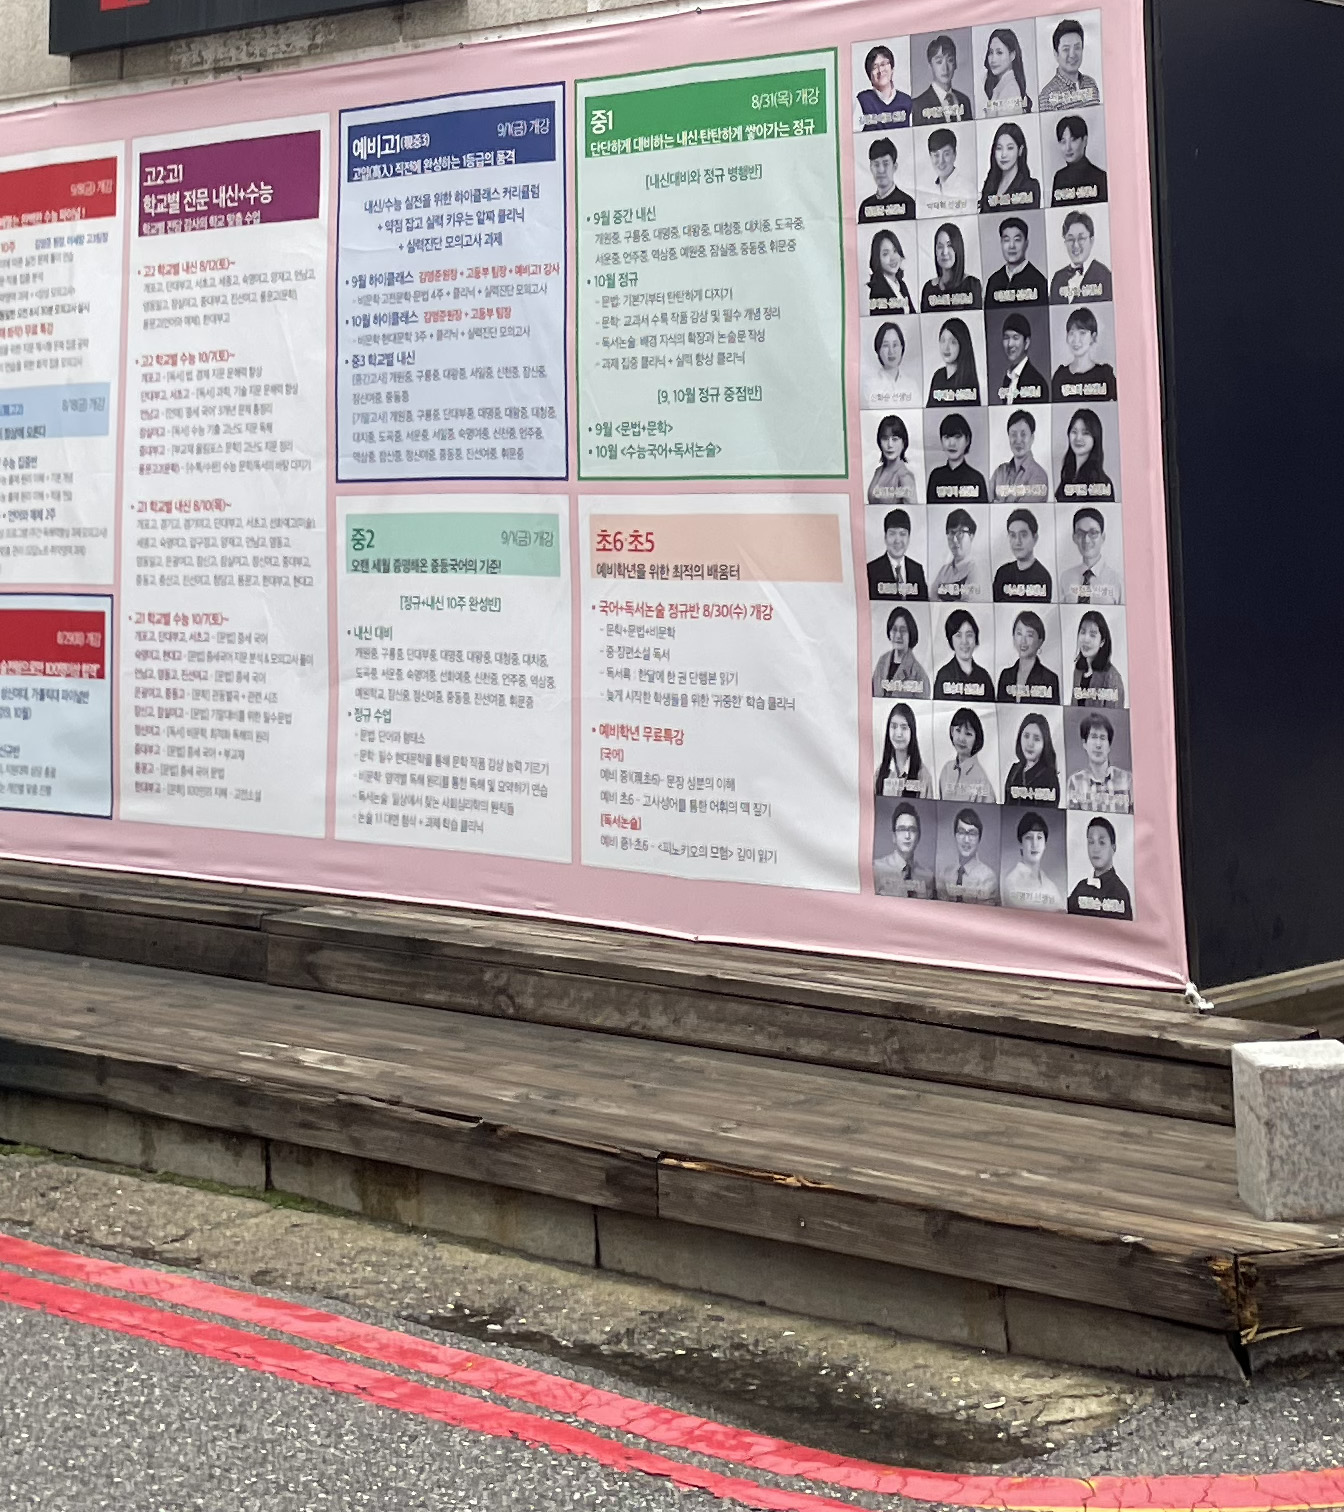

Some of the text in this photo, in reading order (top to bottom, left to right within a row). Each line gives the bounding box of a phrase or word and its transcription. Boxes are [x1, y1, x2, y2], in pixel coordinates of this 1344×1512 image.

[752, 88, 819, 109] 8/31(목) 개강
[529, 118, 550, 135] 개강
[591, 110, 614, 135] 중1
[591, 137, 631, 157] 단단하게
[634, 135, 674, 152] 대비하는
[745, 122, 790, 140] 쌓아가는
[793, 119, 815, 135] 정규
[423, 155, 460, 173] 완성하는
[463, 151, 494, 168] 1등급의
[497, 149, 516, 166] 품격
[645, 164, 762, 190] [내신대비와 정규 병행반]
[143, 181, 274, 217] 학교별 전문 내신+수능
[593, 206, 656, 226] 9월 중간 내신
[594, 272, 638, 288] 10월 정규
[705, 288, 733, 301] 다지기
[763, 306, 781, 319] 정리
[674, 385, 762, 403] 10월 정규 중점반]
[595, 422, 612, 437] 9월
[596, 444, 617, 459] 10월
[351, 528, 375, 551] 중2
[534, 531, 553, 547] 개강
[596, 562, 740, 580] 예비학년을 위한 최적의 배움터
[447, 597, 466, 611] 10주
[599, 600, 773, 621] 국어+독서논술 정규반 8/30(수) 개강
[354, 626, 372, 640] 내신
[599, 723, 684, 746] 예비학년 무료특강
